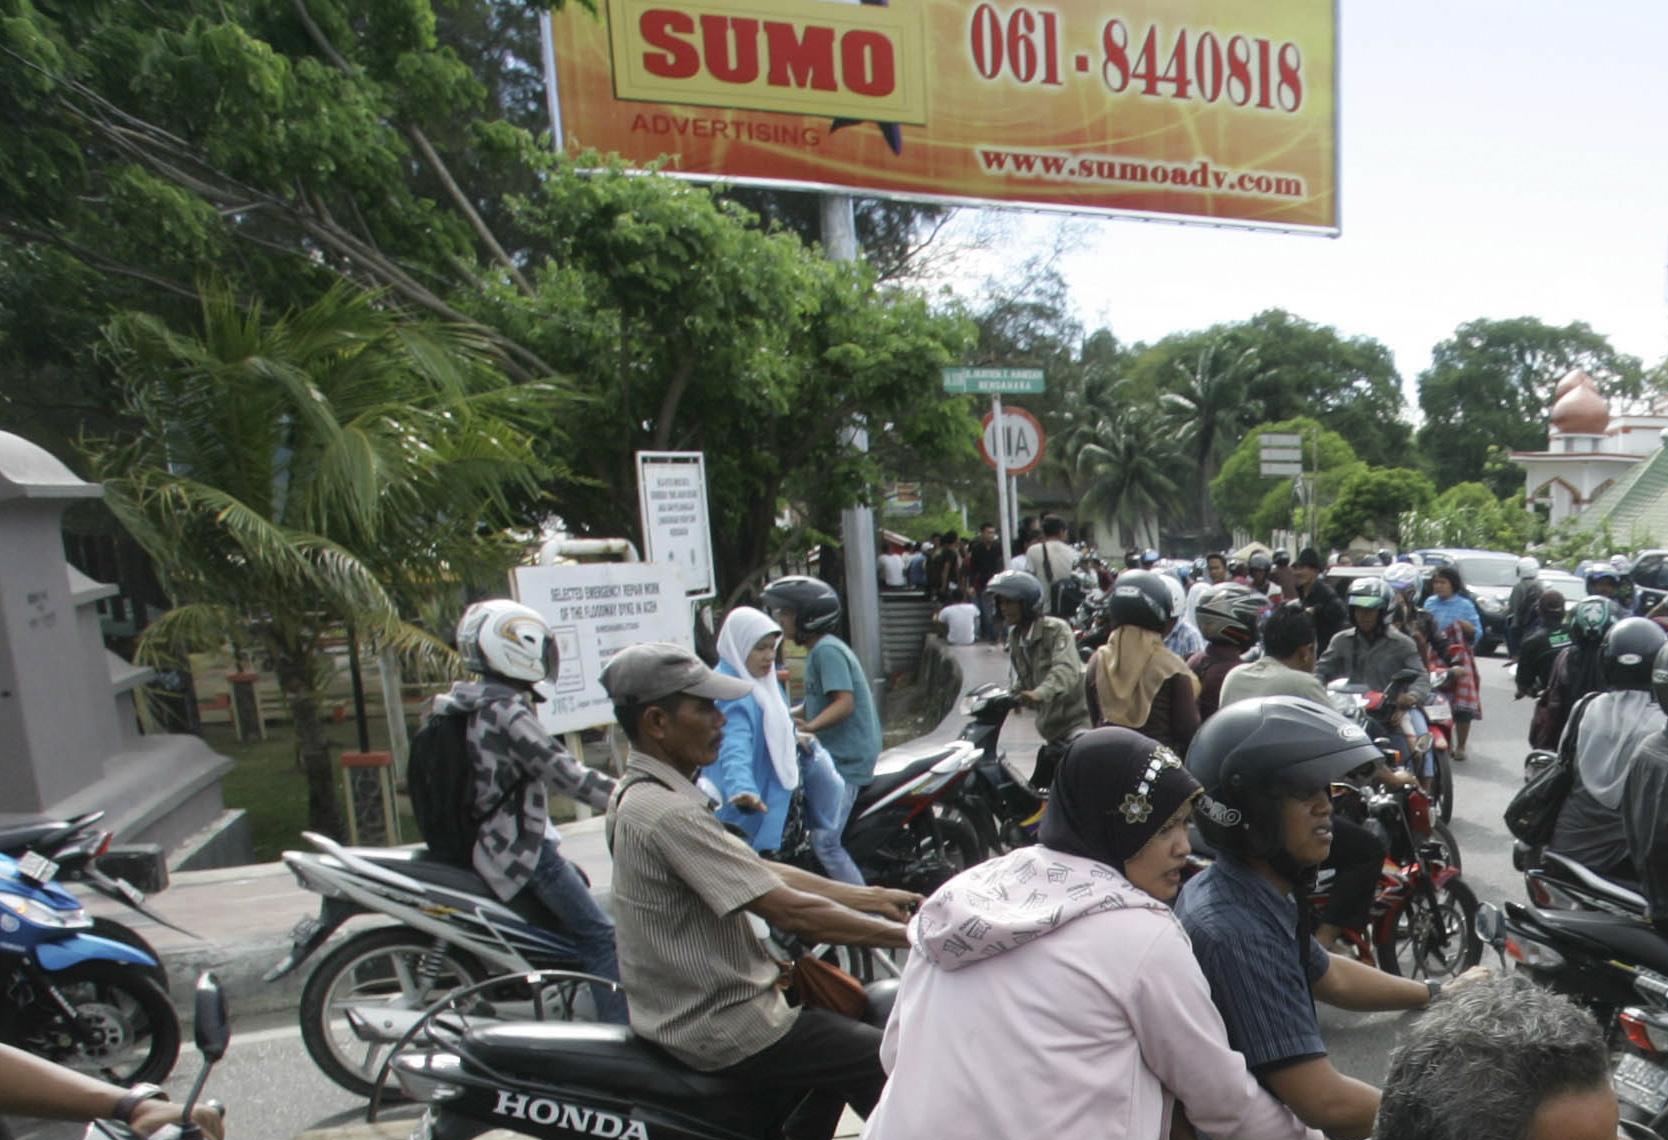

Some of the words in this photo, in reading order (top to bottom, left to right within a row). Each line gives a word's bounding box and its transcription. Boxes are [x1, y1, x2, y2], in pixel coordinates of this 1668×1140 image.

[639, 8, 896, 97] SUMO
[631, 113, 821, 147] ADVERTISING
[980, 149, 1303, 197] www.sumoadv.com
